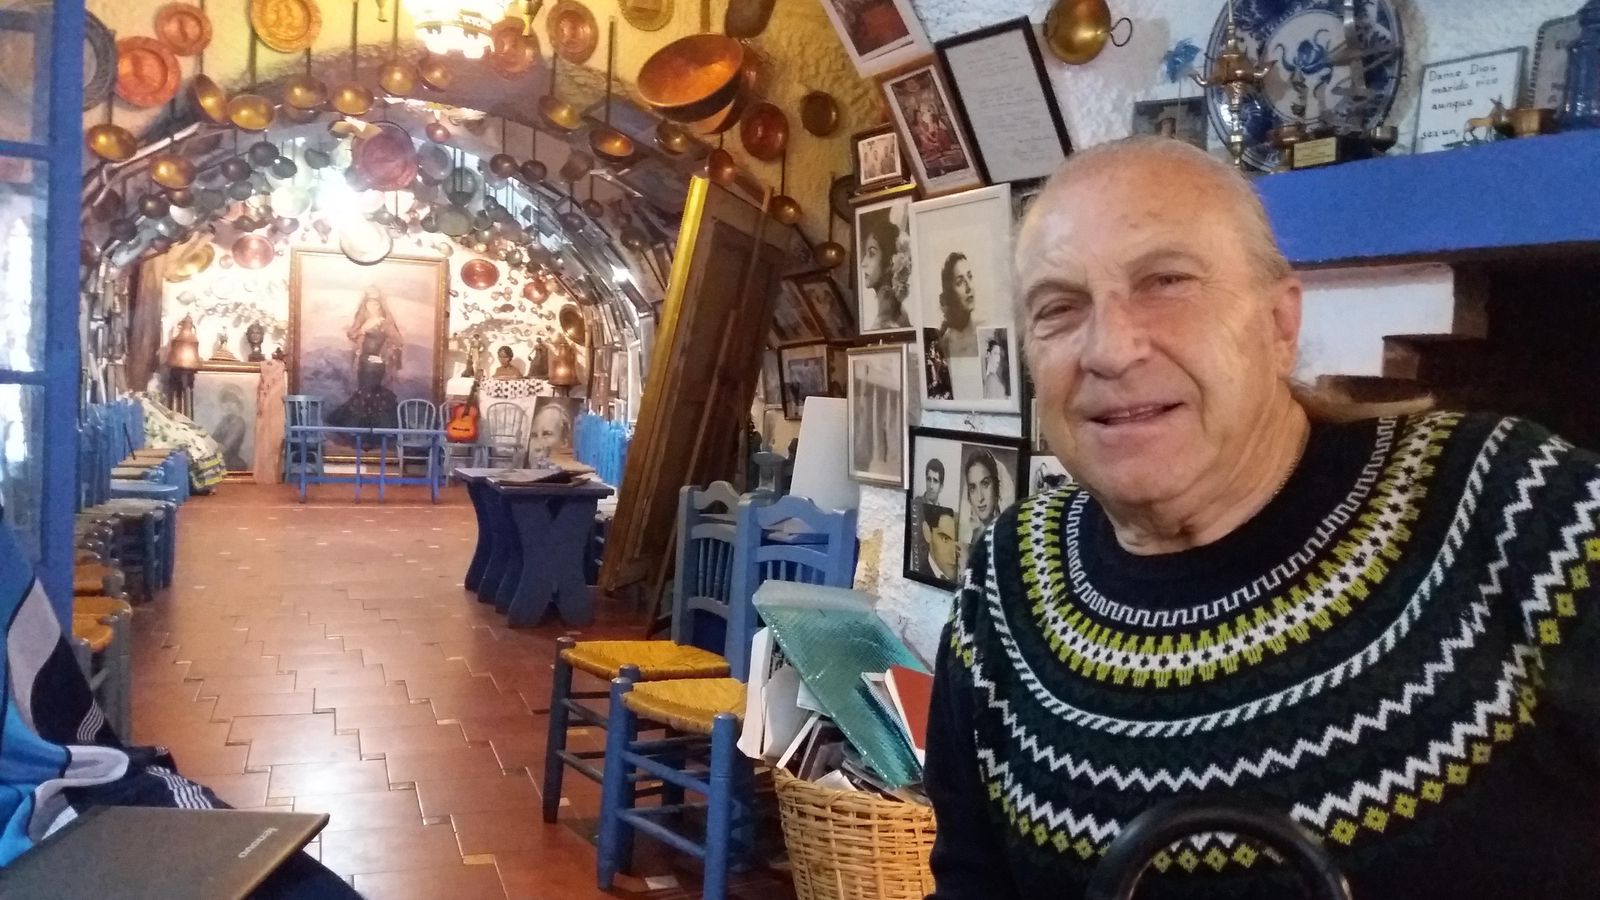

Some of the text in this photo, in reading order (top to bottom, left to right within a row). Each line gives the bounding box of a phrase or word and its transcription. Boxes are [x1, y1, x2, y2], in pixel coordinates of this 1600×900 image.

[1429, 64, 1496, 81] Dame Dios
[1432, 99, 1473, 112] aunque
